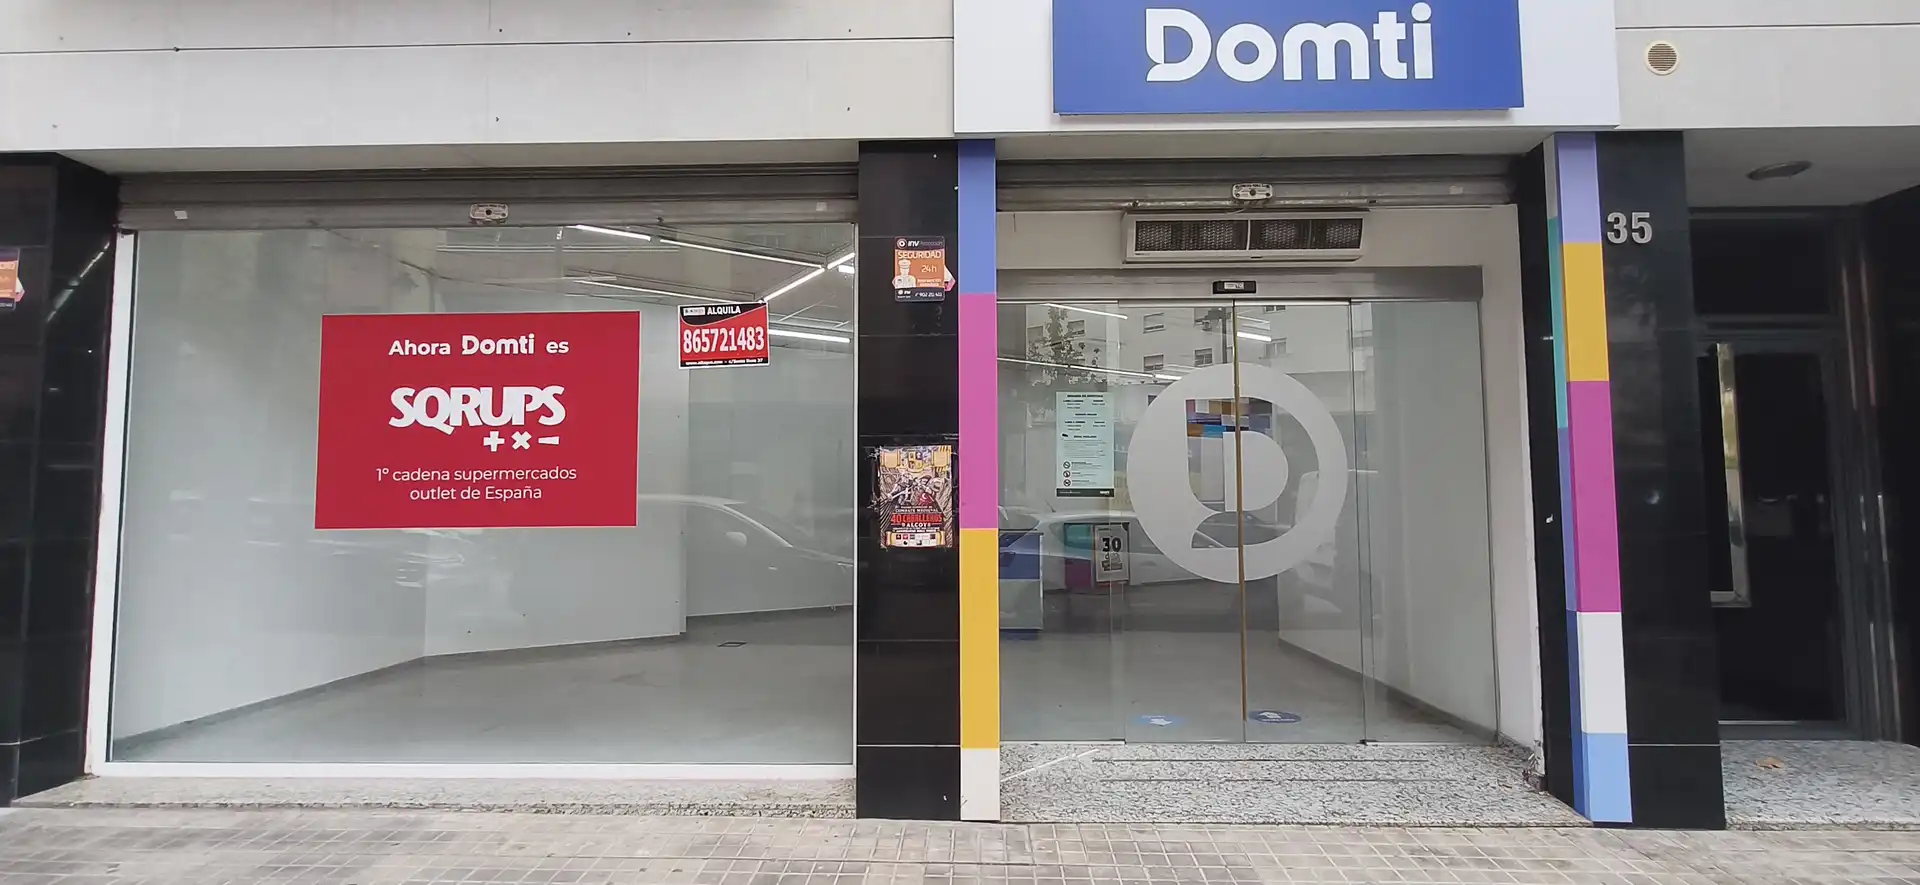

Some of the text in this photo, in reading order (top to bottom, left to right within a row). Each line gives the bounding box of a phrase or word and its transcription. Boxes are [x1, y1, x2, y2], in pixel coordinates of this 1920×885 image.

[1146, 2, 1433, 82] Domti
[1607, 212, 1652, 243] 35
[707, 306, 741, 315] ALQUILA
[389, 334, 569, 355] Ahora Domti es
[683, 327, 764, 353] 865721483
[389, 386, 566, 434] SQRUPS
[392, 468, 450, 481] cadena
[454, 466, 577, 483] supermercados
[410, 486, 542, 502] outlet de España
[1102, 537, 1122, 552] 30
